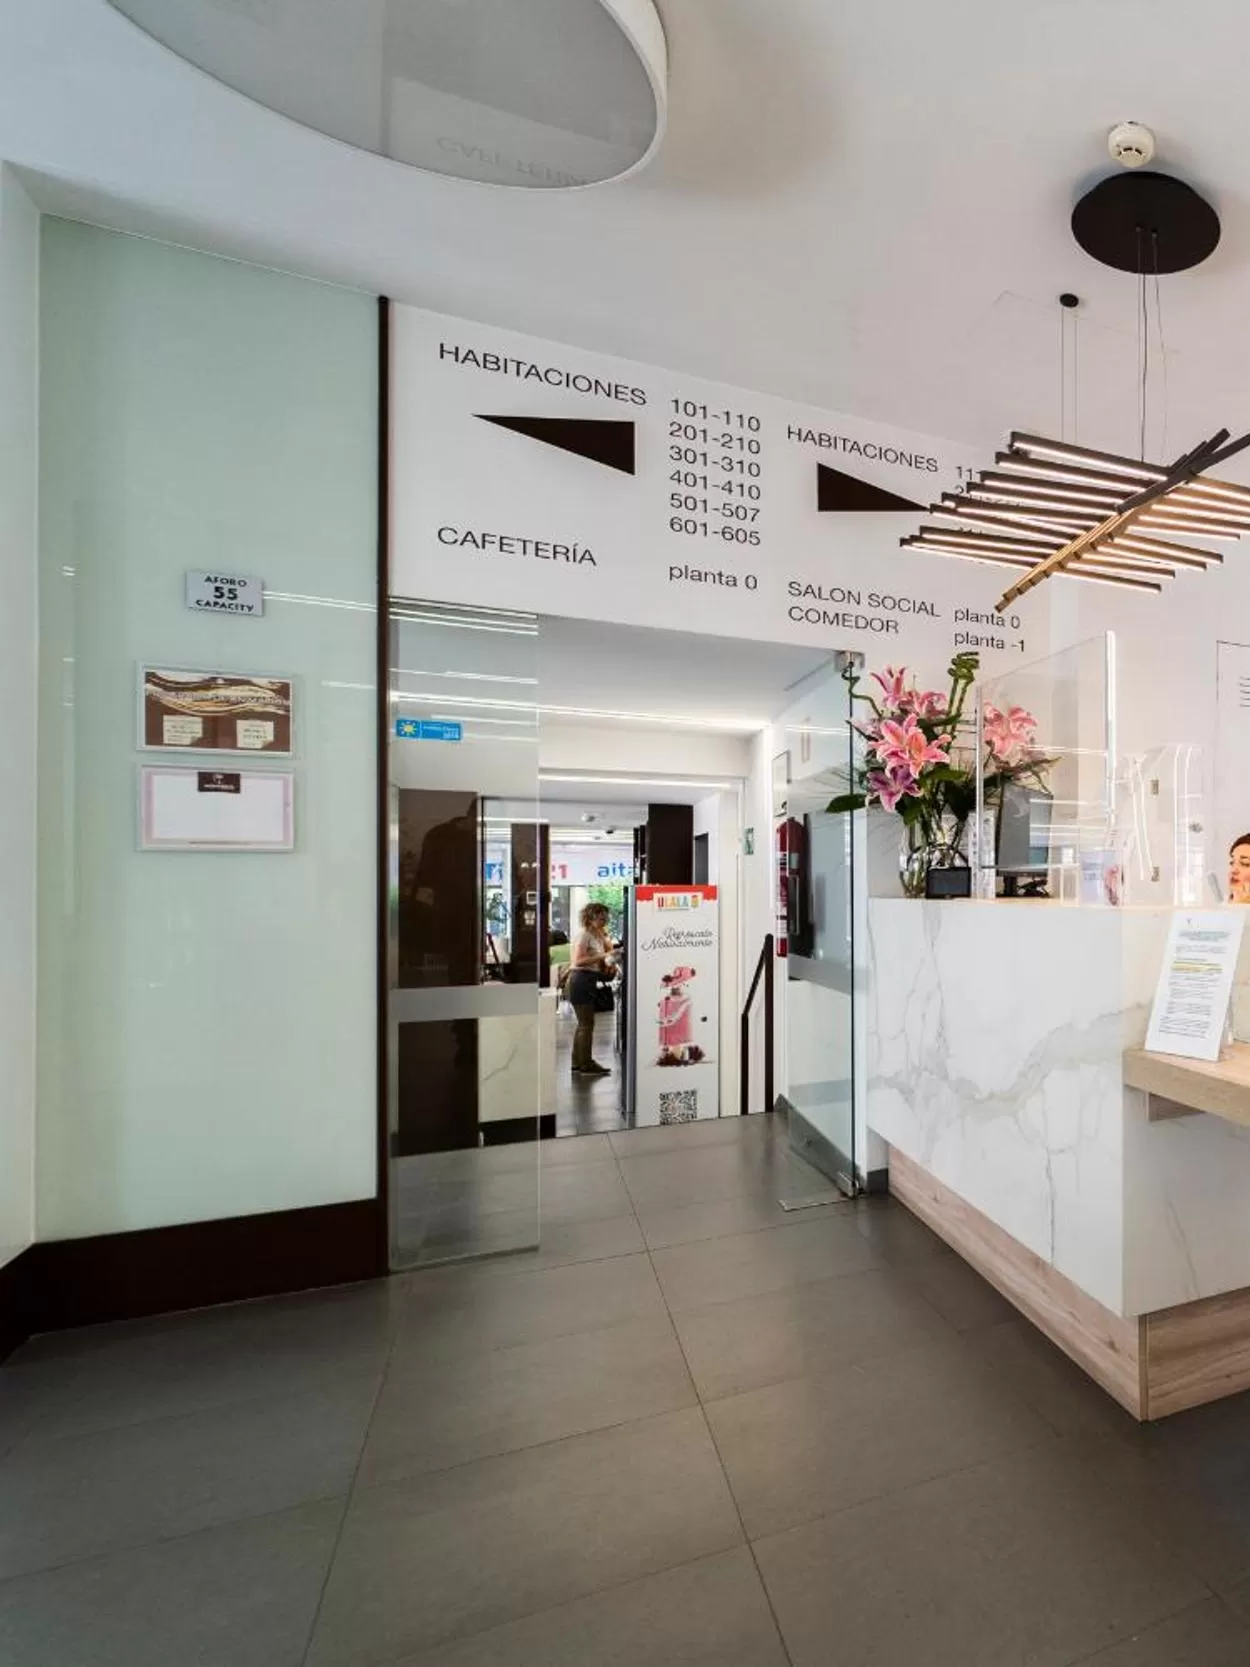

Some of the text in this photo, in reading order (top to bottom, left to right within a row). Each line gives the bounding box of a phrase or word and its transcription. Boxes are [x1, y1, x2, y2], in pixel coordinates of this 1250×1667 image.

[439, 342, 647, 406] HABITACIONES
[670, 399, 761, 432] 101-110
[669, 421, 761, 455] 201-210
[787, 424, 939, 473] HABITACIONES
[669, 444, 761, 478] 301-310
[669, 469, 761, 501] 401-410
[669, 492, 761, 523] 501-507
[437, 526, 597, 566] CAFETERÍA
[669, 516, 761, 546] 601-605
[204, 575, 248, 587] AFORO
[669, 564, 758, 590] planta 0
[195, 599, 254, 612] CAPACITY
[213, 586, 239, 601] 55
[787, 581, 941, 618] SALON SOCIAL
[788, 606, 900, 634] COMEDOR
[954, 608, 1021, 629] planta 0
[954, 631, 1026, 653] planta -1
